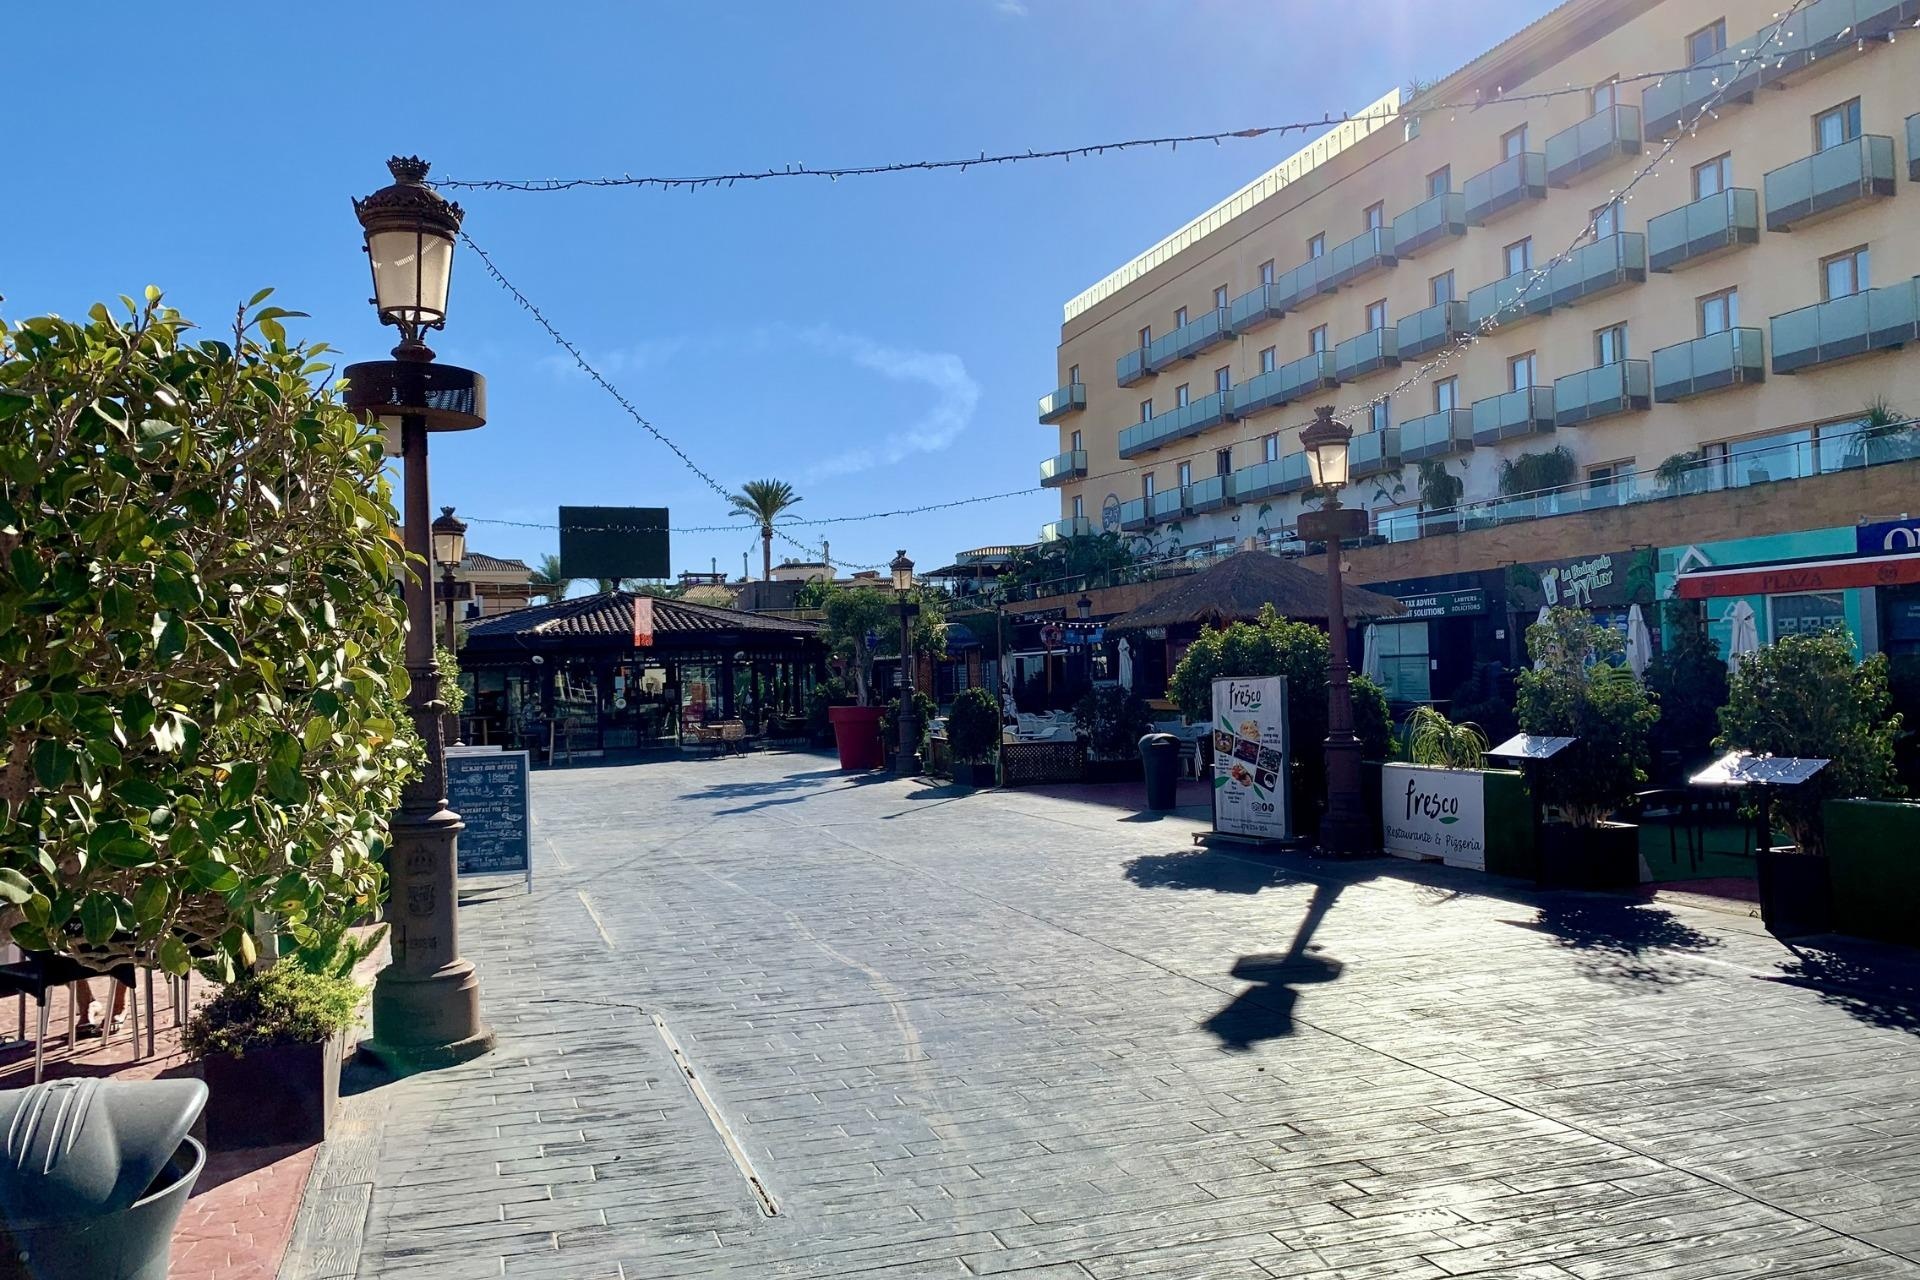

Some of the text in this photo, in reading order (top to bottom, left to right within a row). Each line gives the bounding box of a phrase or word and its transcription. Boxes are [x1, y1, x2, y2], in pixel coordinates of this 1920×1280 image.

[1762, 573, 1823, 590] PLAZA
[1405, 597, 1436, 607] TAX ADVICE
[1454, 595, 1477, 603] LAWYERS
[1414, 606, 1445, 617] SOLUTIONS
[1452, 603, 1481, 612] SOLICITORS
[1230, 682, 1261, 709] fresco
[1405, 778, 1458, 820] fresco
[1385, 825, 1432, 843] Restaurante
[1445, 834, 1480, 852] Pizzeria
